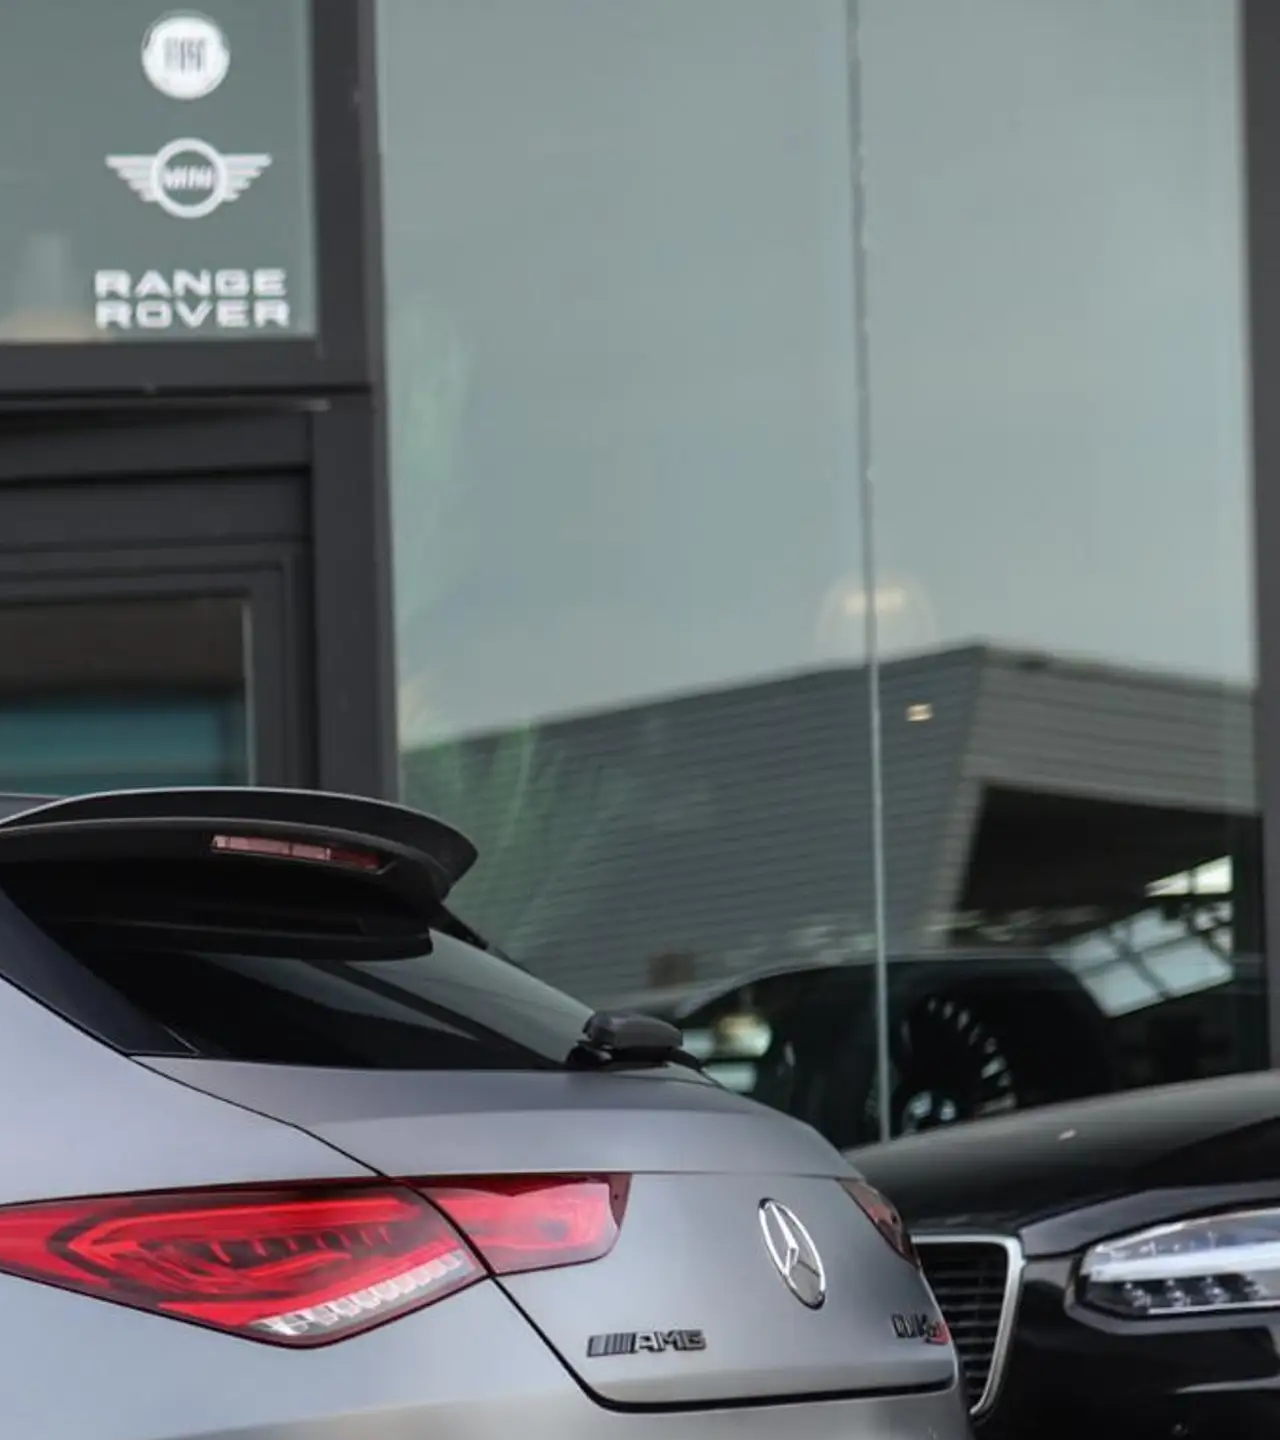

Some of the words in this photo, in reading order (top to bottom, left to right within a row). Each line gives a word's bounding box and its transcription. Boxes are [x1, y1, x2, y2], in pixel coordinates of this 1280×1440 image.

[93, 268, 289, 298] RANGE
[94, 299, 291, 329] ROVER
[637, 1329, 707, 1353] AMG
